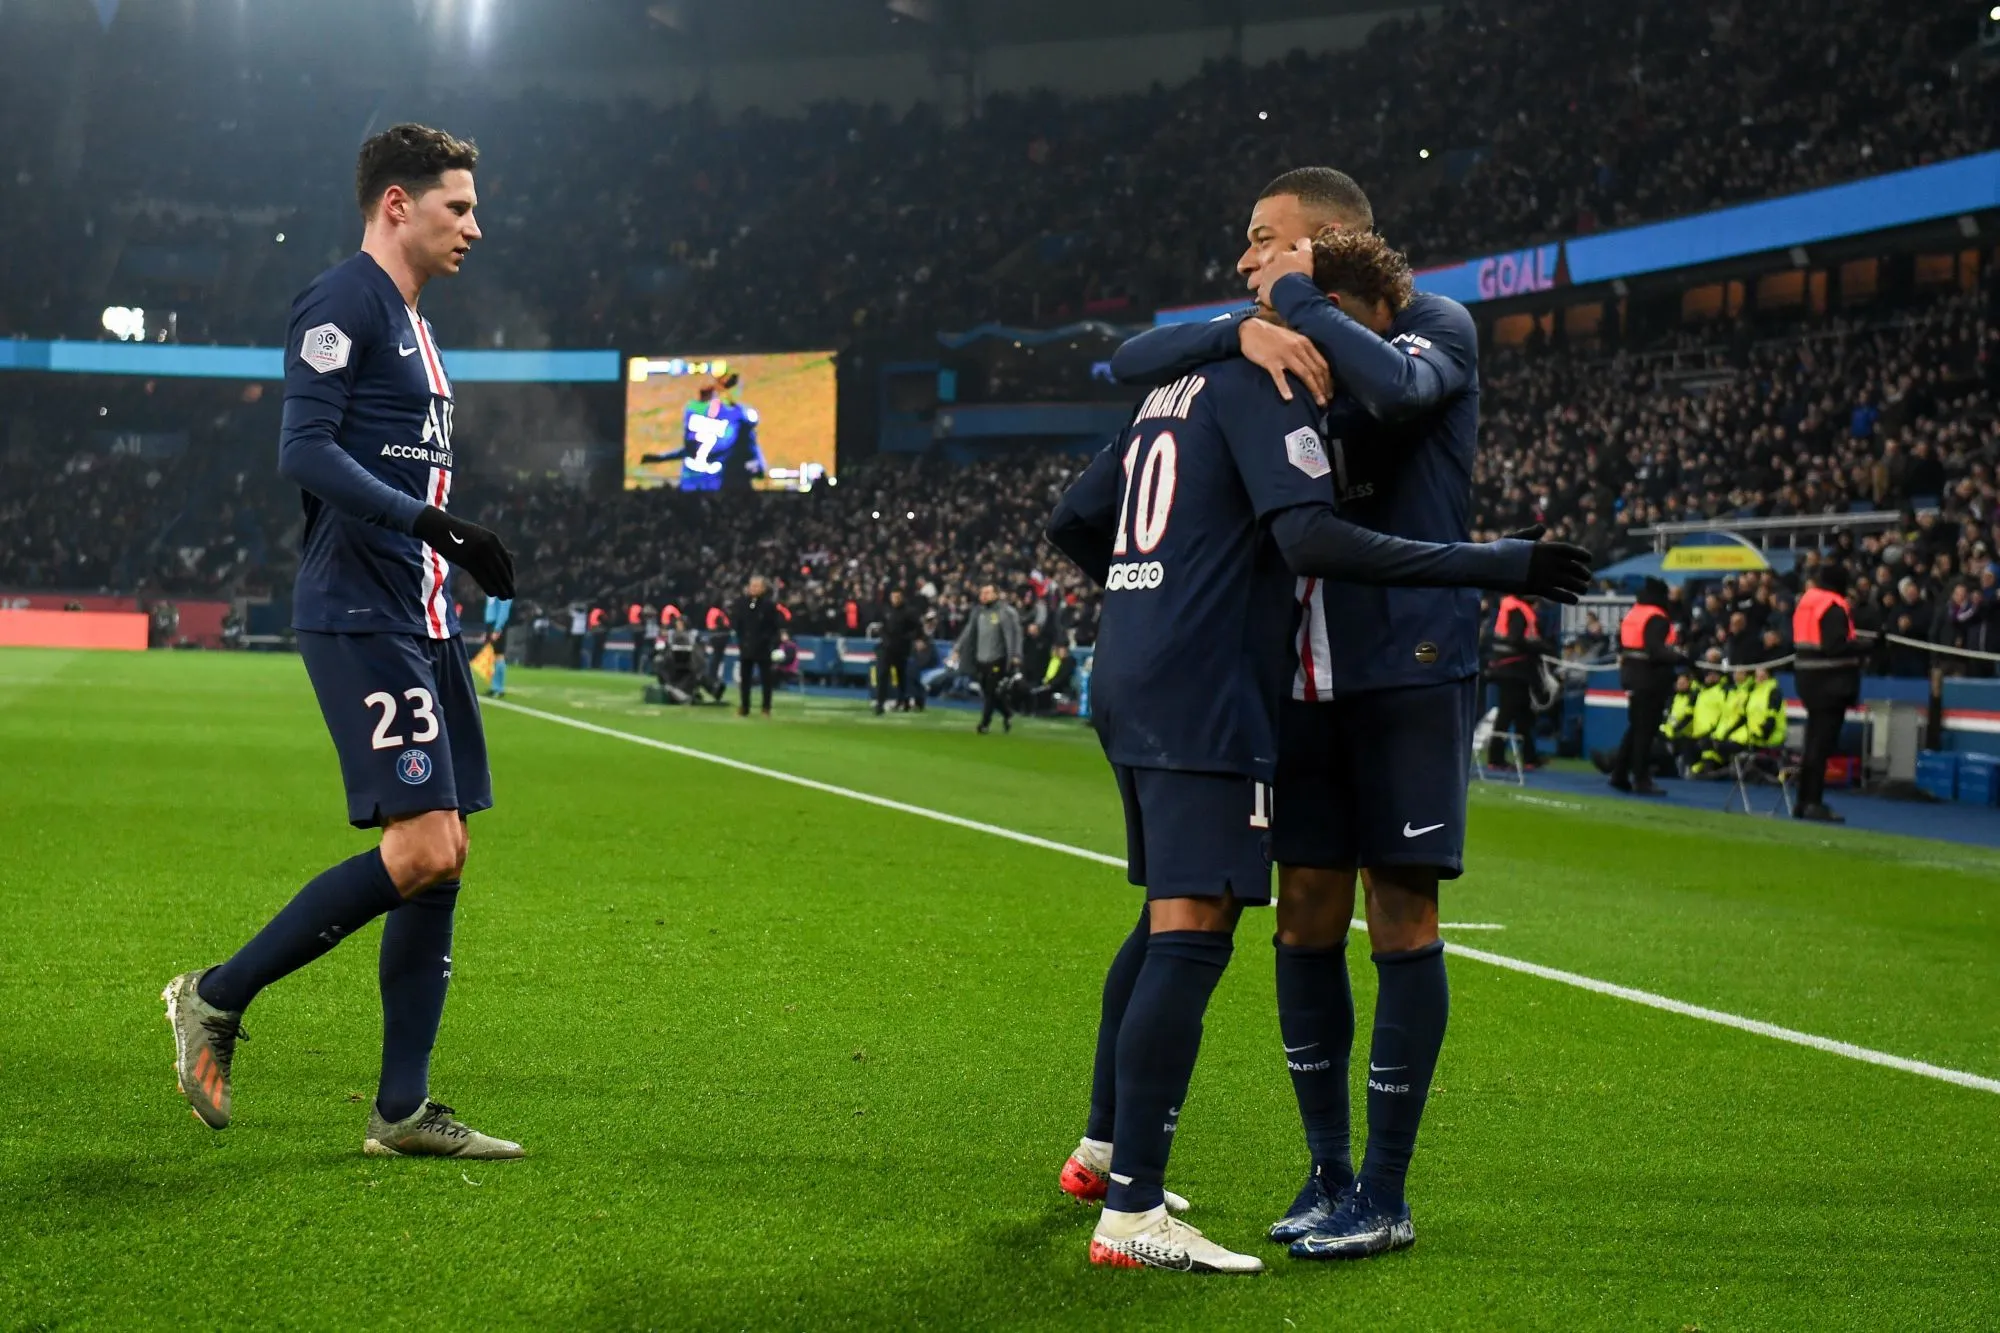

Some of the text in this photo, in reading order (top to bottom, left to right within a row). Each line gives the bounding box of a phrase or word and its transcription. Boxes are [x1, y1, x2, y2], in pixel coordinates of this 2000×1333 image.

[1478, 248, 1554, 299] GOAL
[1390, 333, 1432, 349] NB
[380, 443, 429, 461] ACCOR
[430, 450, 447, 465] LIVE
[1112, 430, 1178, 555] 10
[363, 687, 439, 750] 23
[1249, 782, 1274, 828] 1
[1287, 1060, 1330, 1072] PARIS
[1368, 1079, 1410, 1093] PARIS
